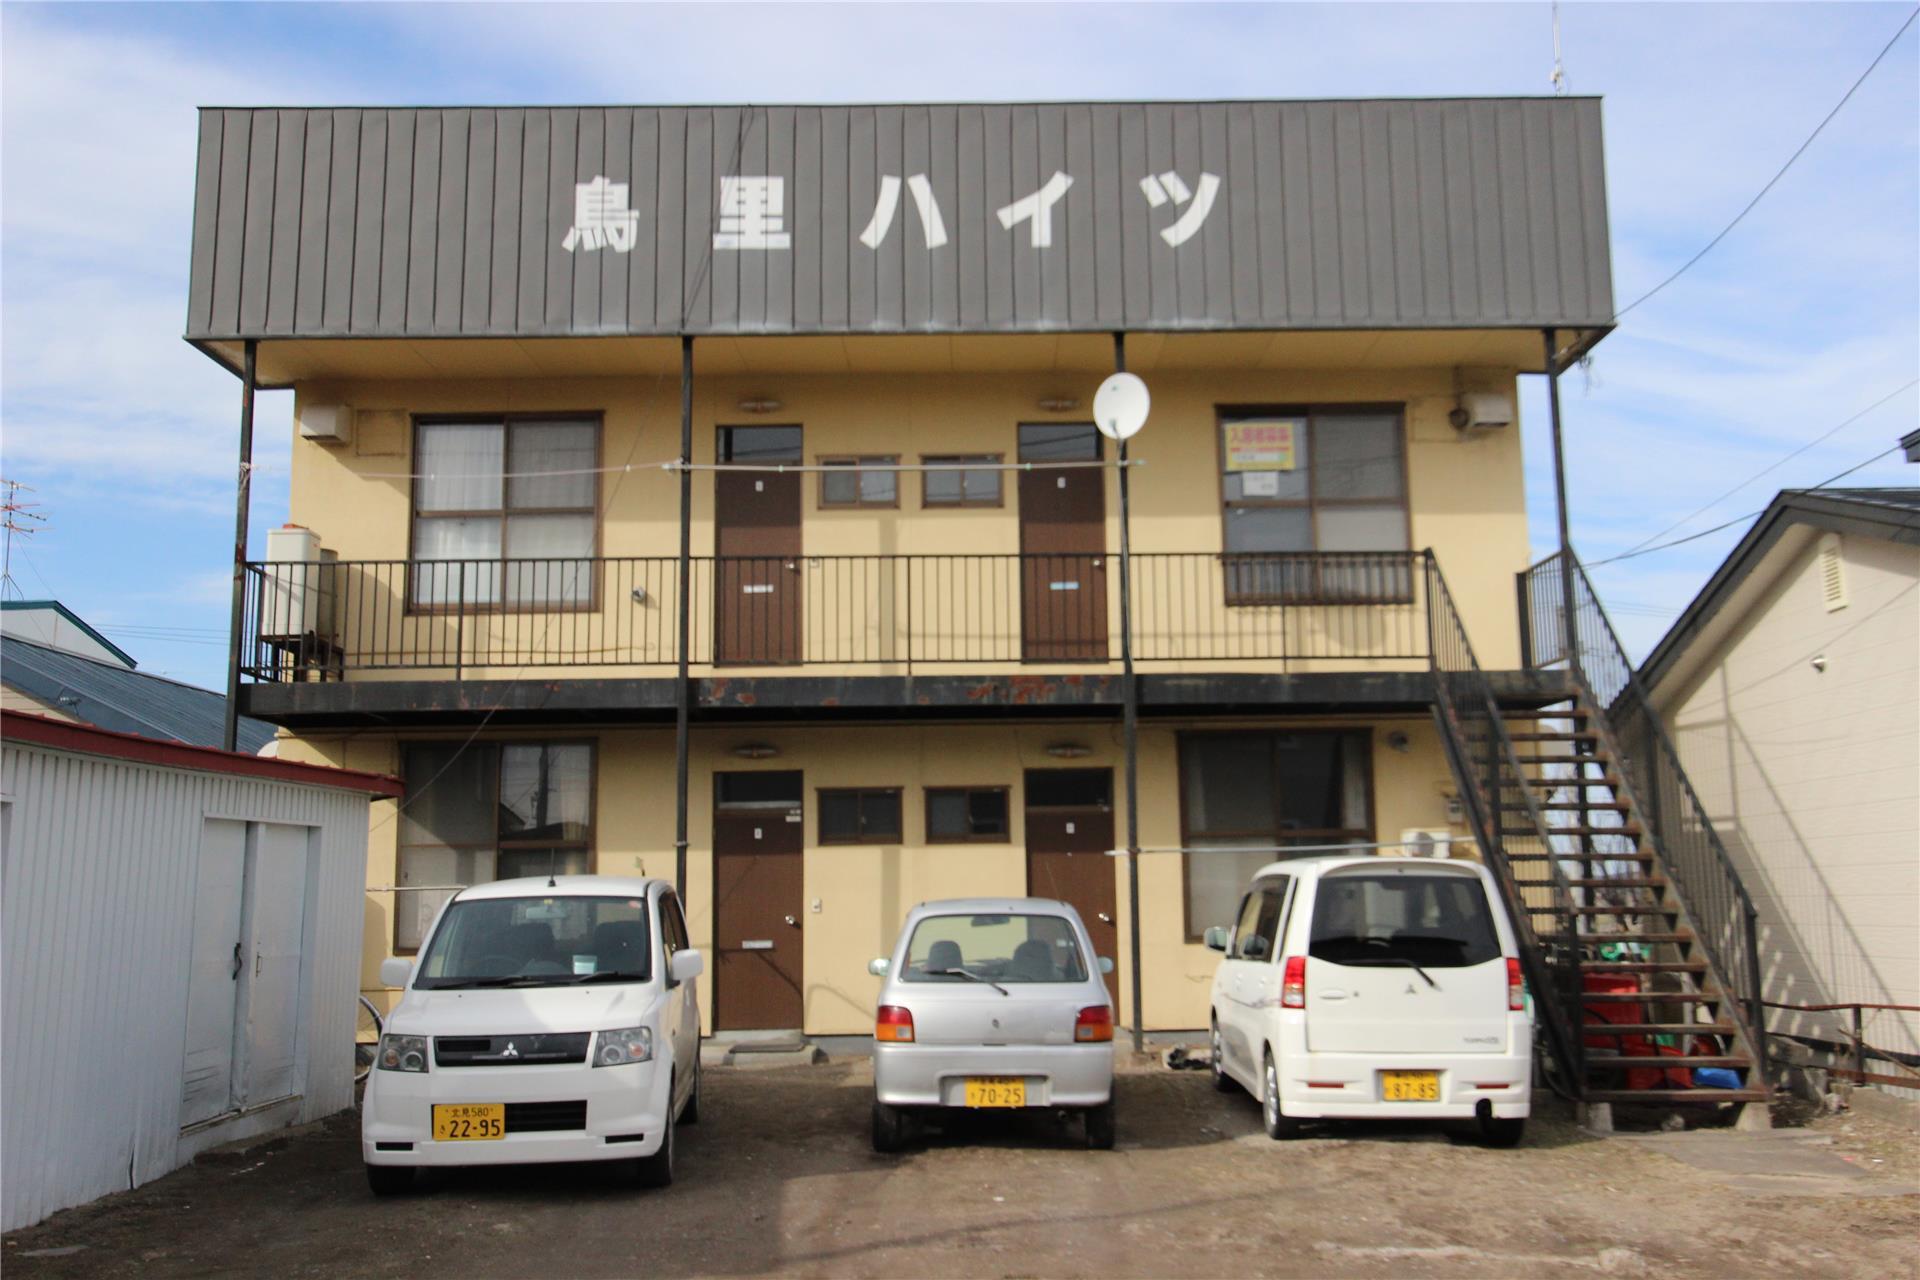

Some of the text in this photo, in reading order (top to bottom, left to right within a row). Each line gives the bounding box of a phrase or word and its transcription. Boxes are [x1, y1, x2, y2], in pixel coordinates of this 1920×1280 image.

[562, 172, 1220, 252] 鳥里ハイツ
[978, 1087, 1022, 1105] 70-25
[449, 1118, 501, 1138] 22-95
